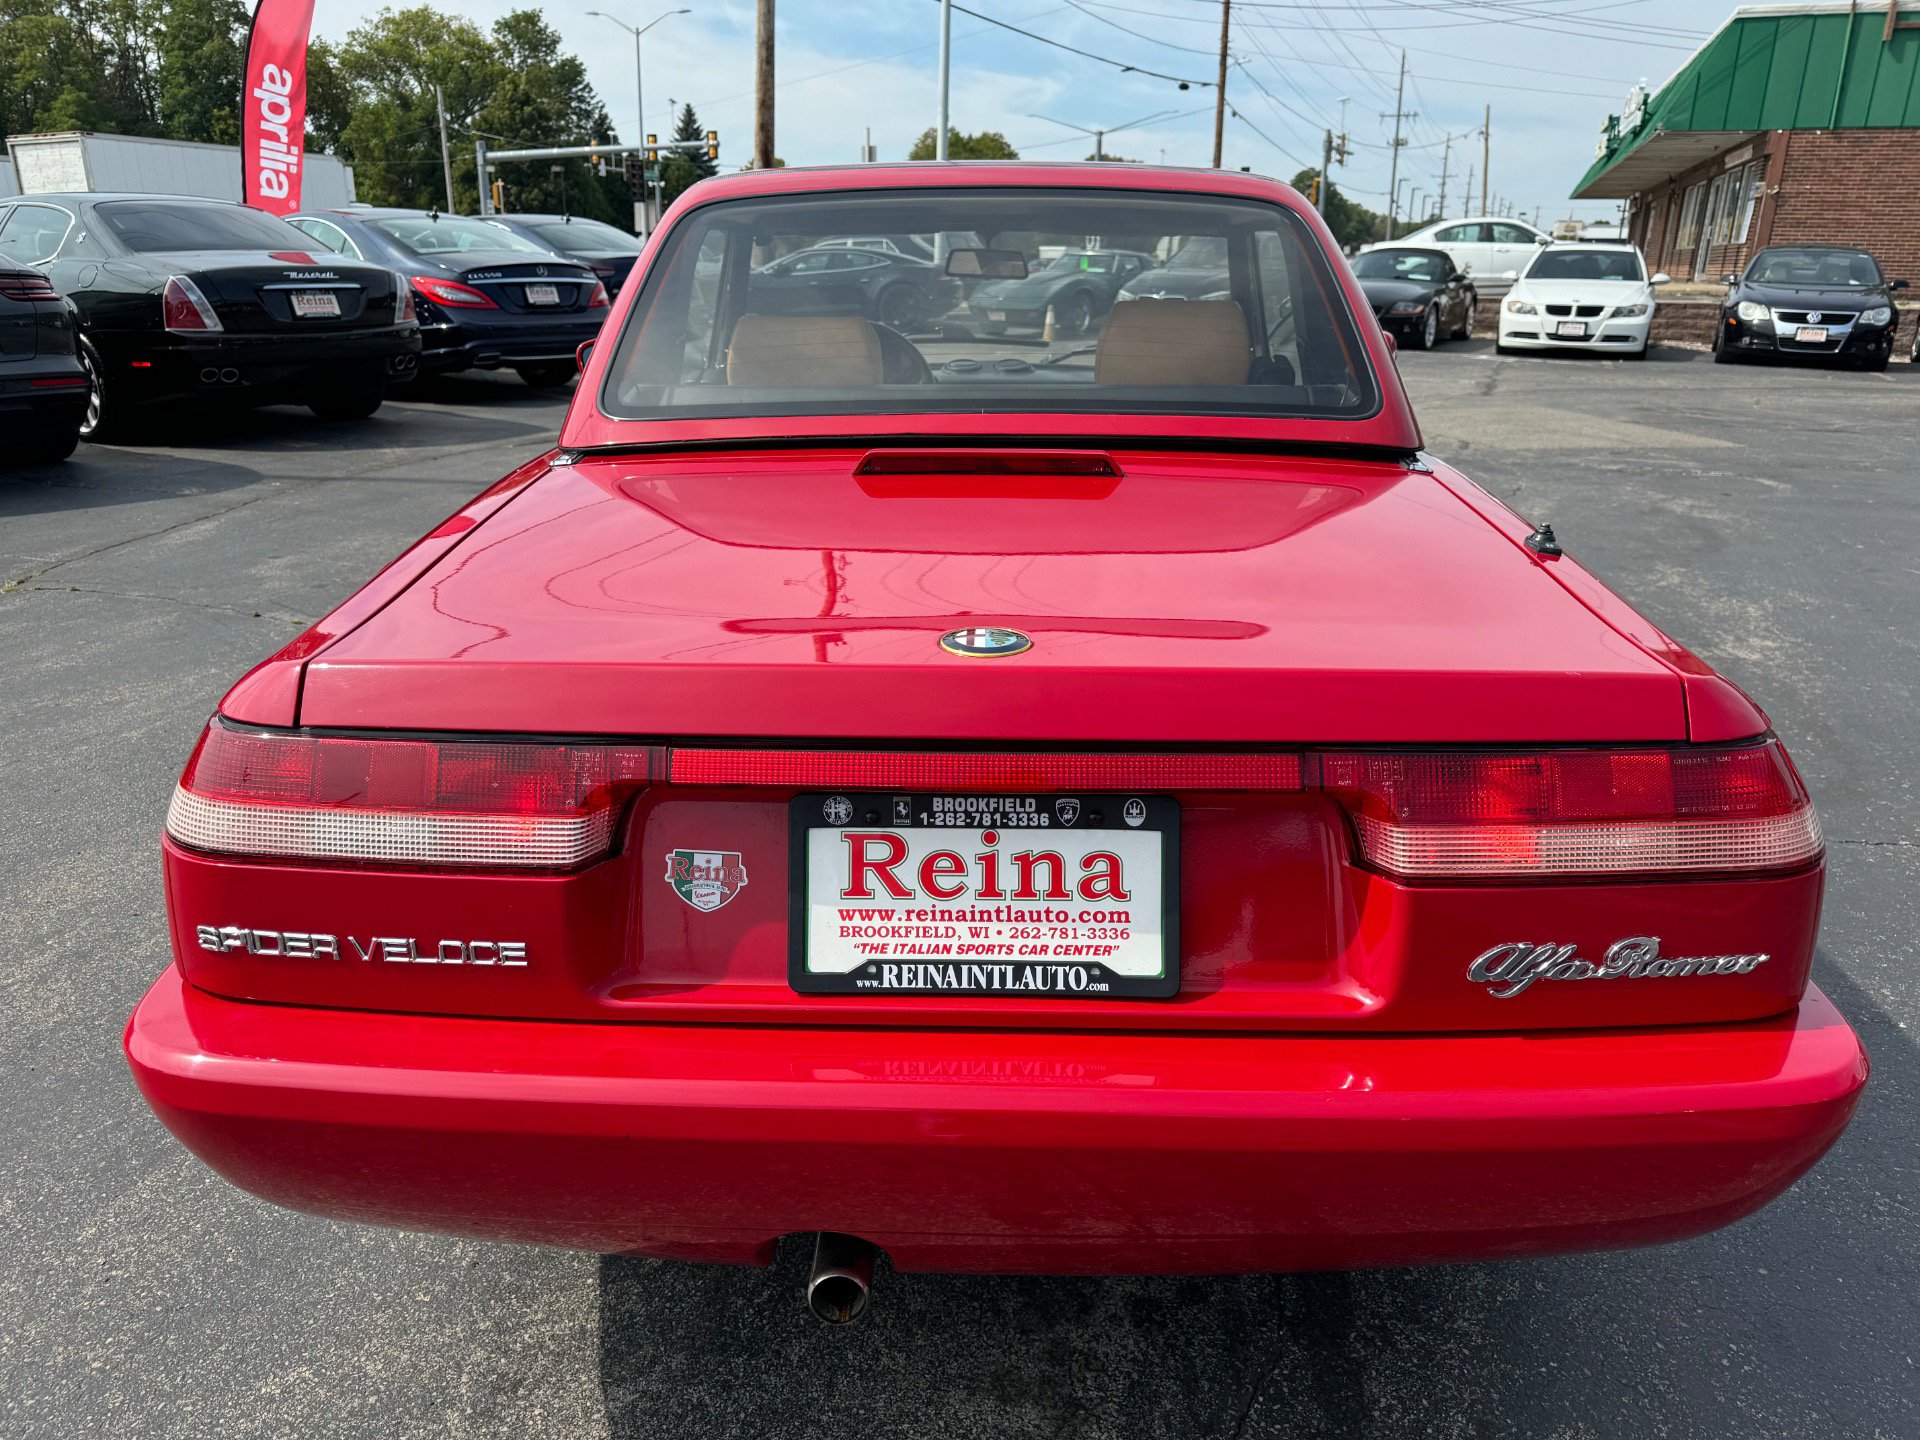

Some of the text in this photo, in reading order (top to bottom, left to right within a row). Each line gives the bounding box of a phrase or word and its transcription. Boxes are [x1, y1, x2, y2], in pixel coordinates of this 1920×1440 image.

[253, 63, 298, 199] aprilia
[283, 271, 339, 279] Maserati
[296, 295, 334, 306] Reina
[932, 797, 1036, 813] BROOKFIELD
[919, 812, 1050, 827] 1-262-781-3336
[668, 856, 745, 883] Reina
[840, 828, 1132, 902] Reina
[837, 904, 1132, 924] www.reinaintlauto.com
[838, 925, 1131, 941] BROOKFIELD, WI 262-781-3336
[197, 925, 528, 967] SPIDER VELOCE
[892, 943, 953, 955] ITALIAN
[955, 943, 1015, 956] SPORTS
[1018, 944, 1050, 956] CAR
[1466, 934, 1771, 999] Alfa Romeo
